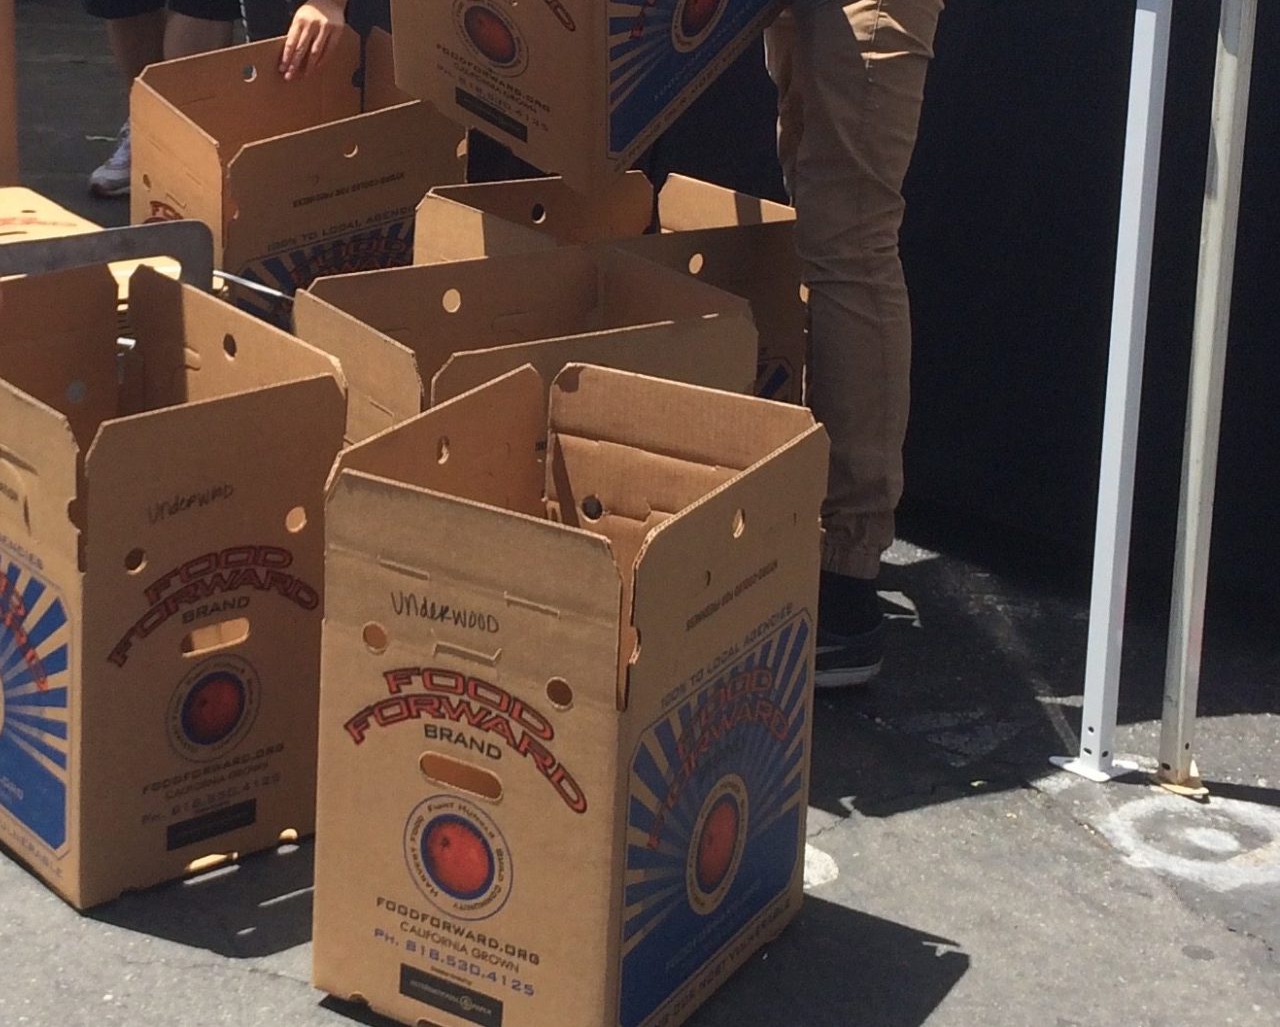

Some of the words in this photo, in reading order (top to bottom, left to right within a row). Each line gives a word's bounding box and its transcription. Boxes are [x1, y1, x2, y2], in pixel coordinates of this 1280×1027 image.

[302, 230, 318, 242] TO
[322, 219, 363, 238] LOCAL
[144, 544, 293, 608] FOOD
[107, 567, 319, 668] FORWARD
[181, 596, 250, 624] BRAND
[383, 667, 554, 742] FOOD
[142, 742, 284, 795] FOODFORWARD.ORG
[343, 693, 588, 814] FORWARD
[424, 723, 502, 761] BRAND
[376, 896, 540, 966] FOODFORWARD.ORG
[400, 921, 469, 955] CALIFORNIA
[471, 947, 520, 974] GROWN
[405, 941, 535, 997] 818.530.4125
